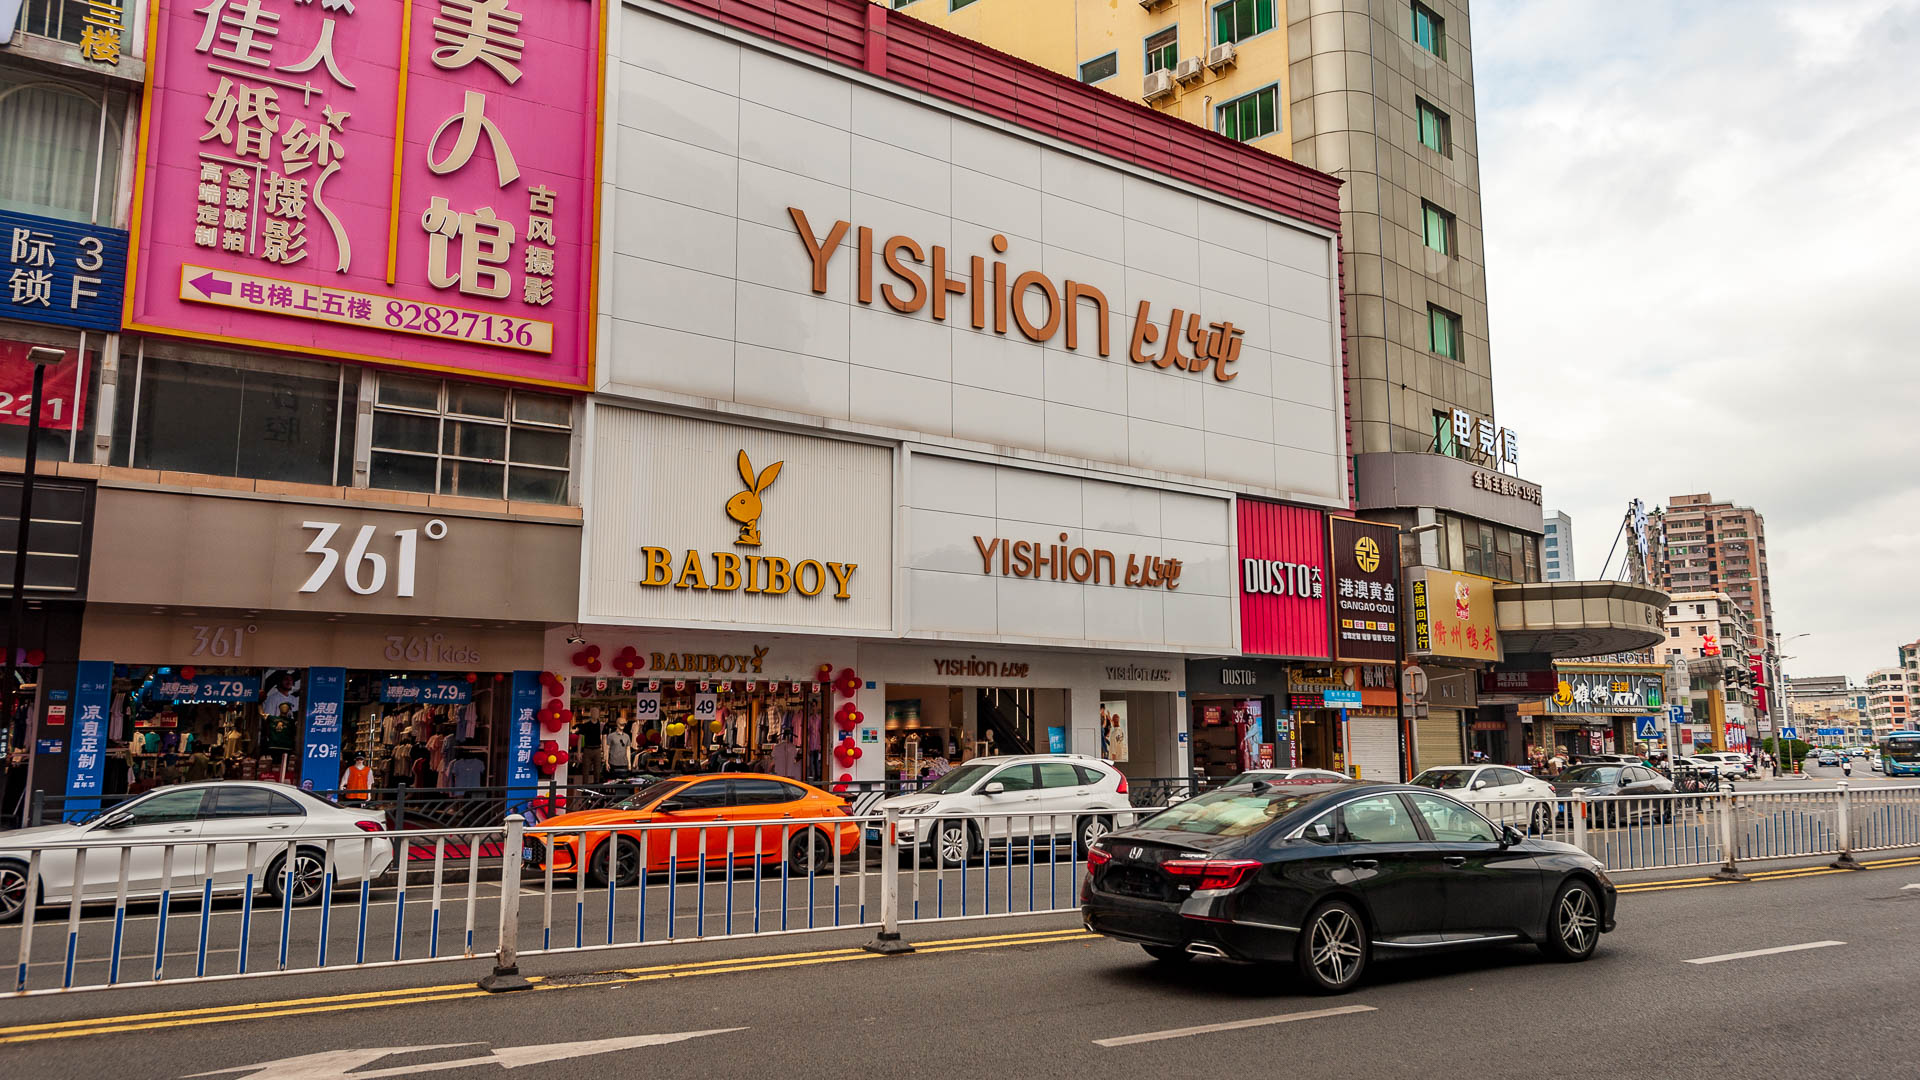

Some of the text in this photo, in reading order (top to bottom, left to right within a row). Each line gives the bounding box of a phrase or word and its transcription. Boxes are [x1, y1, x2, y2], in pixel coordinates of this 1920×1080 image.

[194, 162, 223, 248] 高端定制
[222, 168, 251, 253] 全球旅拍
[262, 172, 308, 264] 摄影
[523, 184, 557, 306] 古风摄影
[240, 281, 532, 347] 电梯上五楼 82827136
[640, 546, 858, 599] BABIBOY
[1243, 558, 1311, 598] DUSTO
[1339, 578, 1395, 602] 港澳黄金
[1340, 600, 1395, 614] GANGAO GOL
[1413, 581, 1429, 649] 金银回收行
[650, 652, 751, 673] BABIBOY
[1222, 669, 1252, 685] DUSTO
[639, 699, 657, 713] 99
[697, 700, 714, 713] 49
[1671, 706, 1681, 723] P
[307, 744, 329, 758] 7.9
